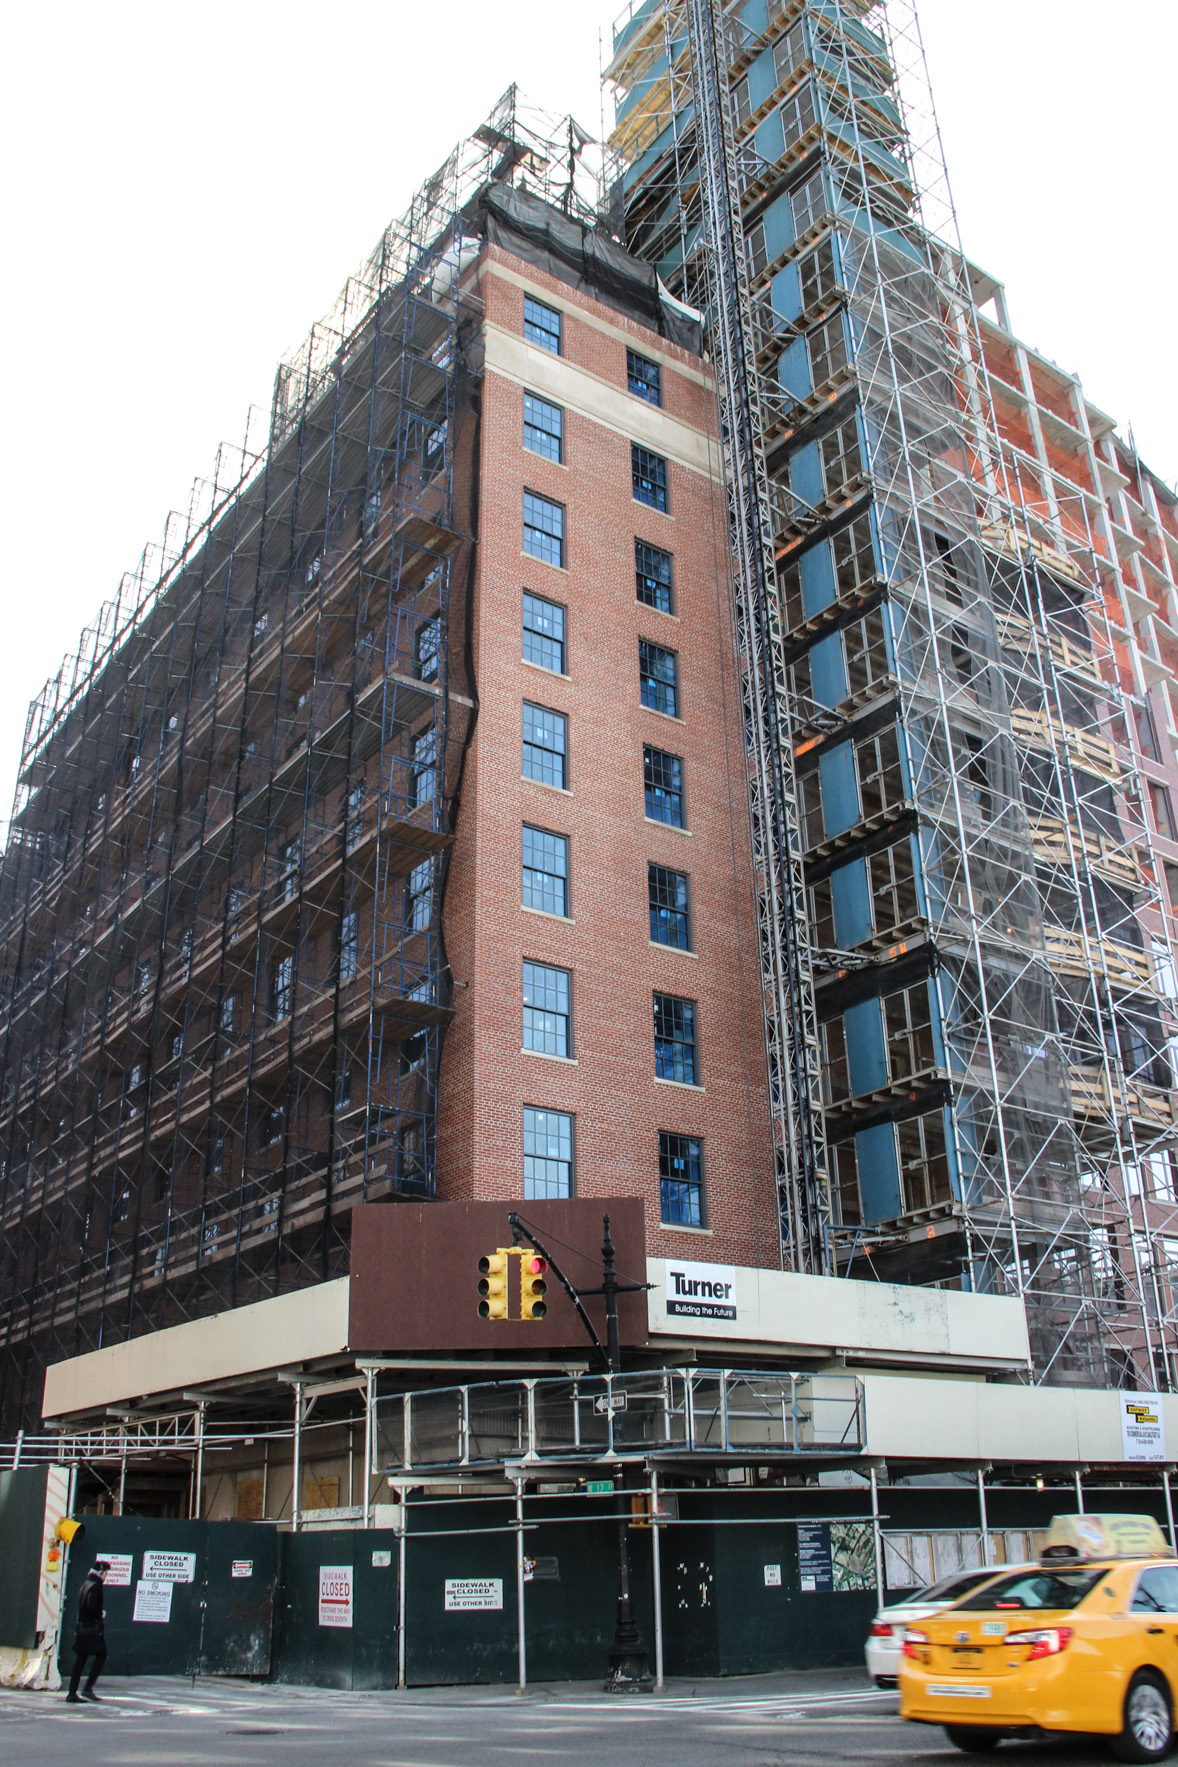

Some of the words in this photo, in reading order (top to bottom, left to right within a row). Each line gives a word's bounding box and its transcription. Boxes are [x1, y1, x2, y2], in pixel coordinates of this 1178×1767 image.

[670, 1271, 732, 1299] Turner
[675, 1304, 700, 1316] Building
[702, 1306, 712, 1315] the
[713, 1308, 733, 1317] Future
[324, 1572, 347, 1580] SIDEWALK
[321, 1582, 350, 1597] CLOSED
